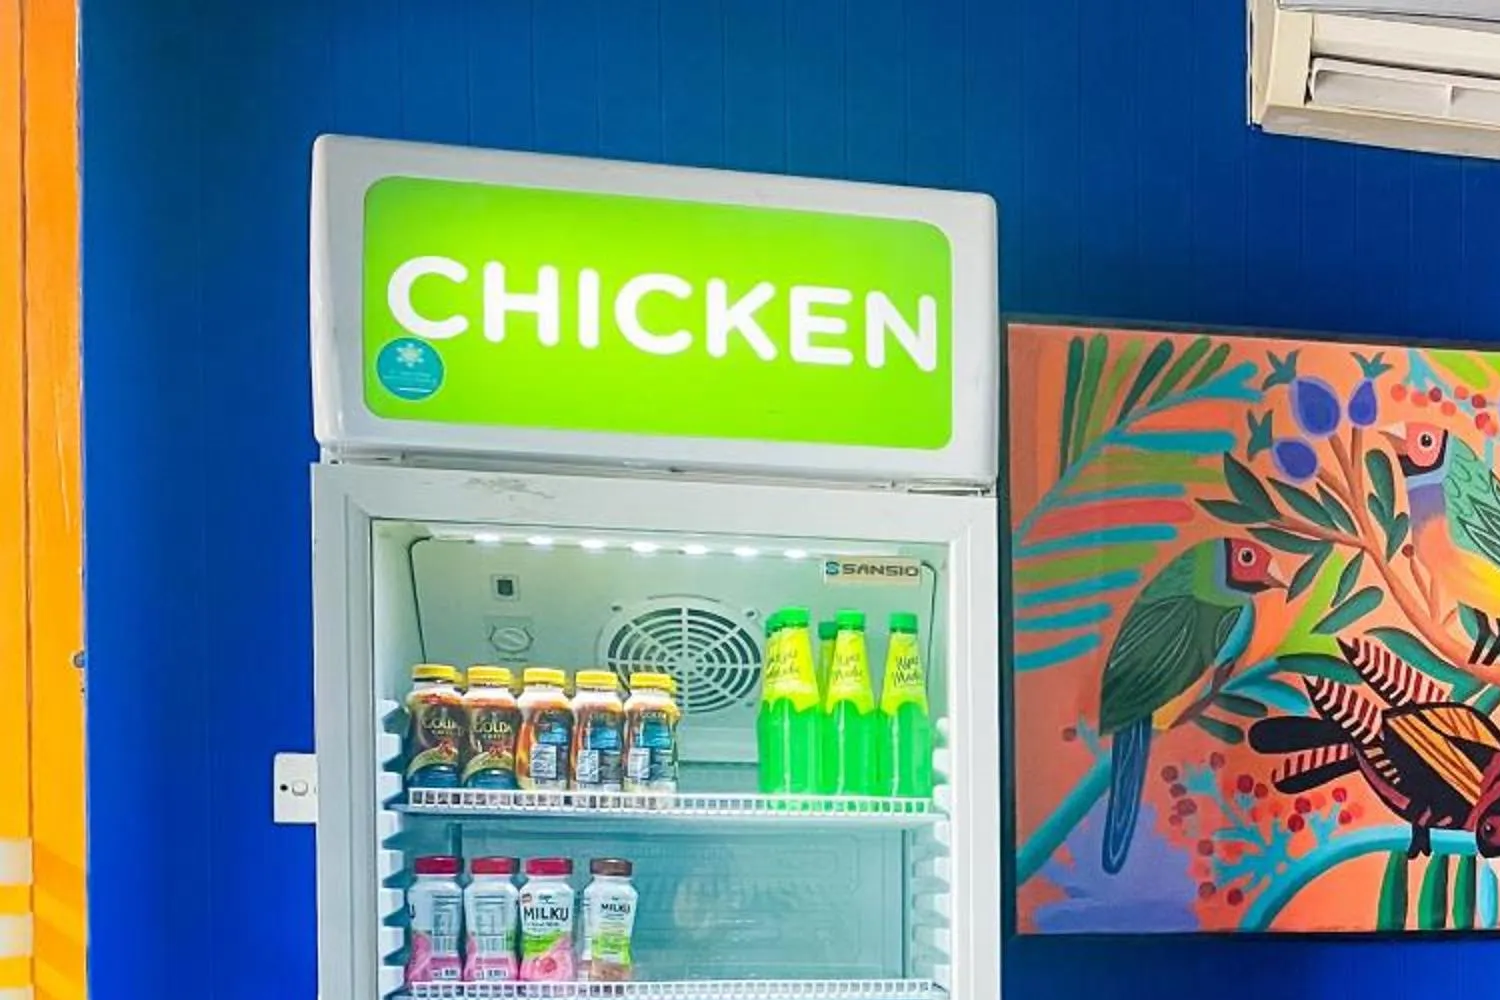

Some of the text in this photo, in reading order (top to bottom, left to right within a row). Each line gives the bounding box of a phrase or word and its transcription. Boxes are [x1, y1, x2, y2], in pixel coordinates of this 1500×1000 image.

[387, 255, 938, 372] CHICKEN
[842, 563, 919, 577] SANSIO
[523, 906, 569, 922] MILKU
[600, 902, 631, 915] MILKU
